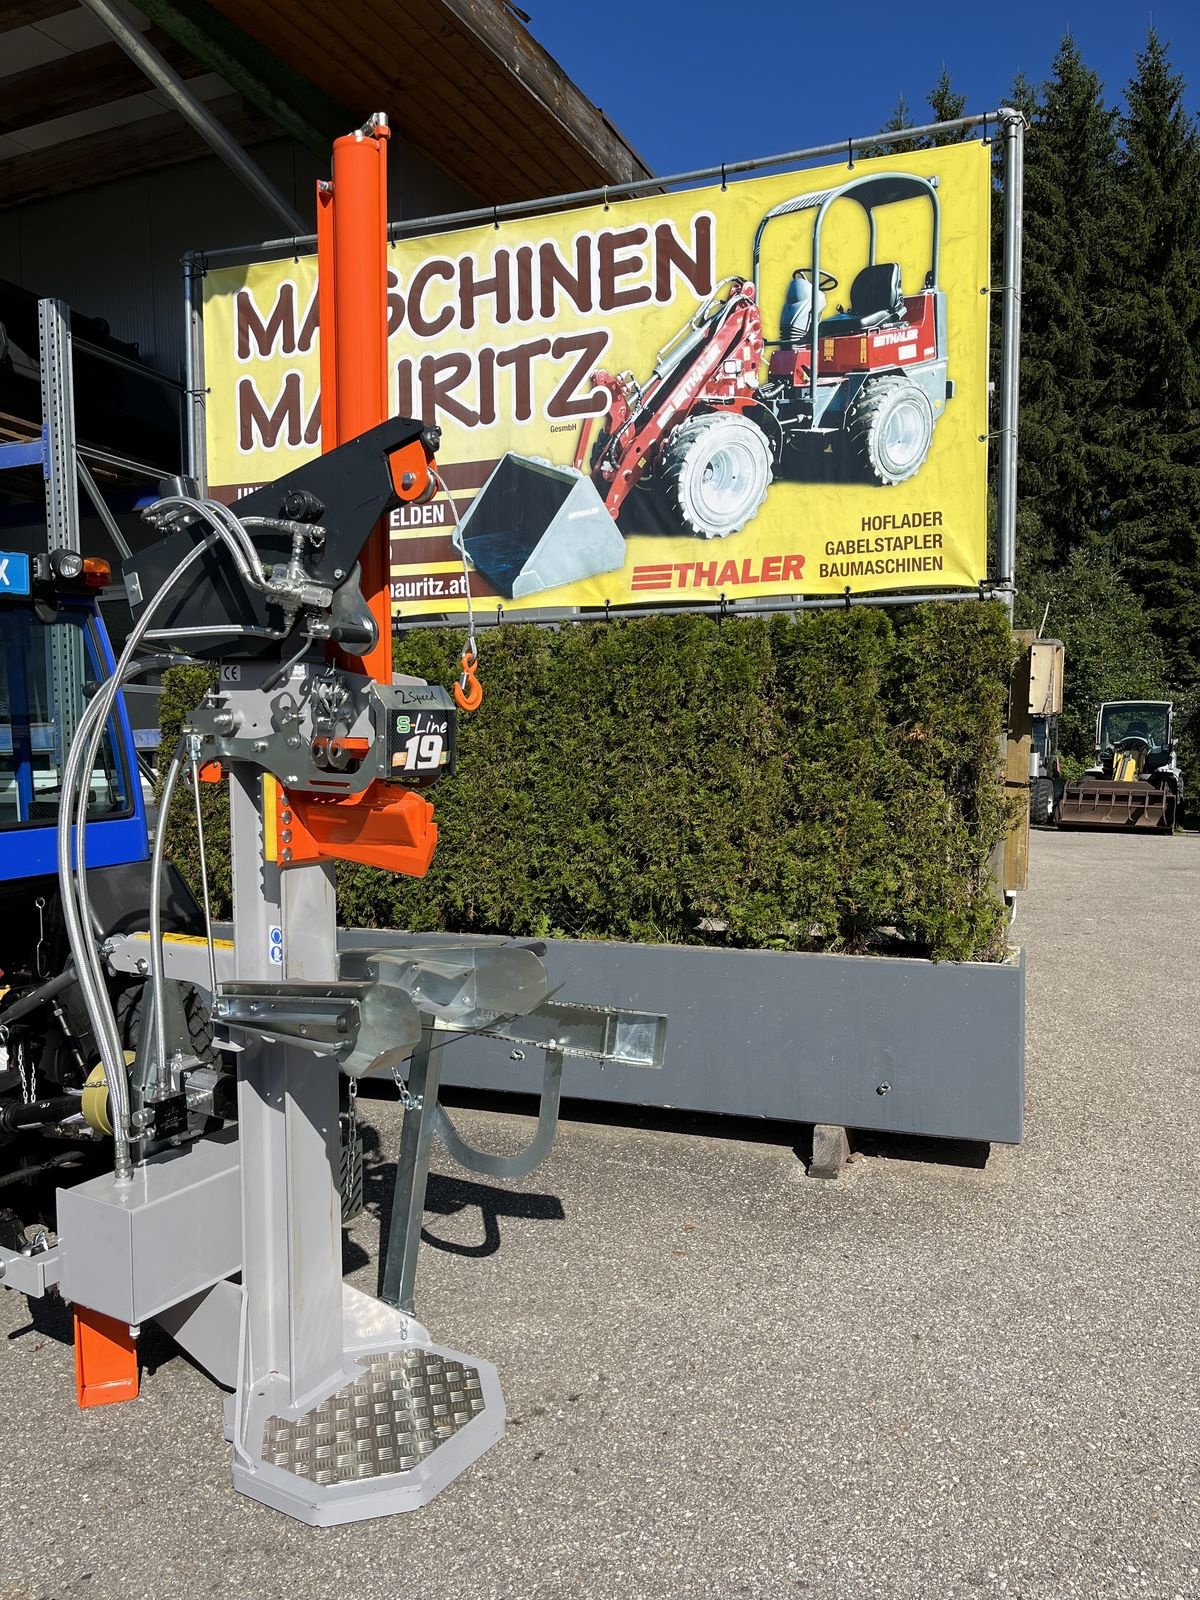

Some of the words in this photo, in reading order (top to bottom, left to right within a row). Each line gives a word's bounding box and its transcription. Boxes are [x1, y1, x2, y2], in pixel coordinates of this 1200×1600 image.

[239, 330, 612, 451] MRITZ
[550, 423, 577, 433] GesmbH
[861, 511, 943, 532] HOFLADER
[825, 533, 943, 556] GABELSTAPLER
[819, 555, 943, 578] BAUMASCHINEN
[394, 690, 411, 704] 2
[396, 713, 448, 735] S-Line
[403, 734, 443, 771] 19
